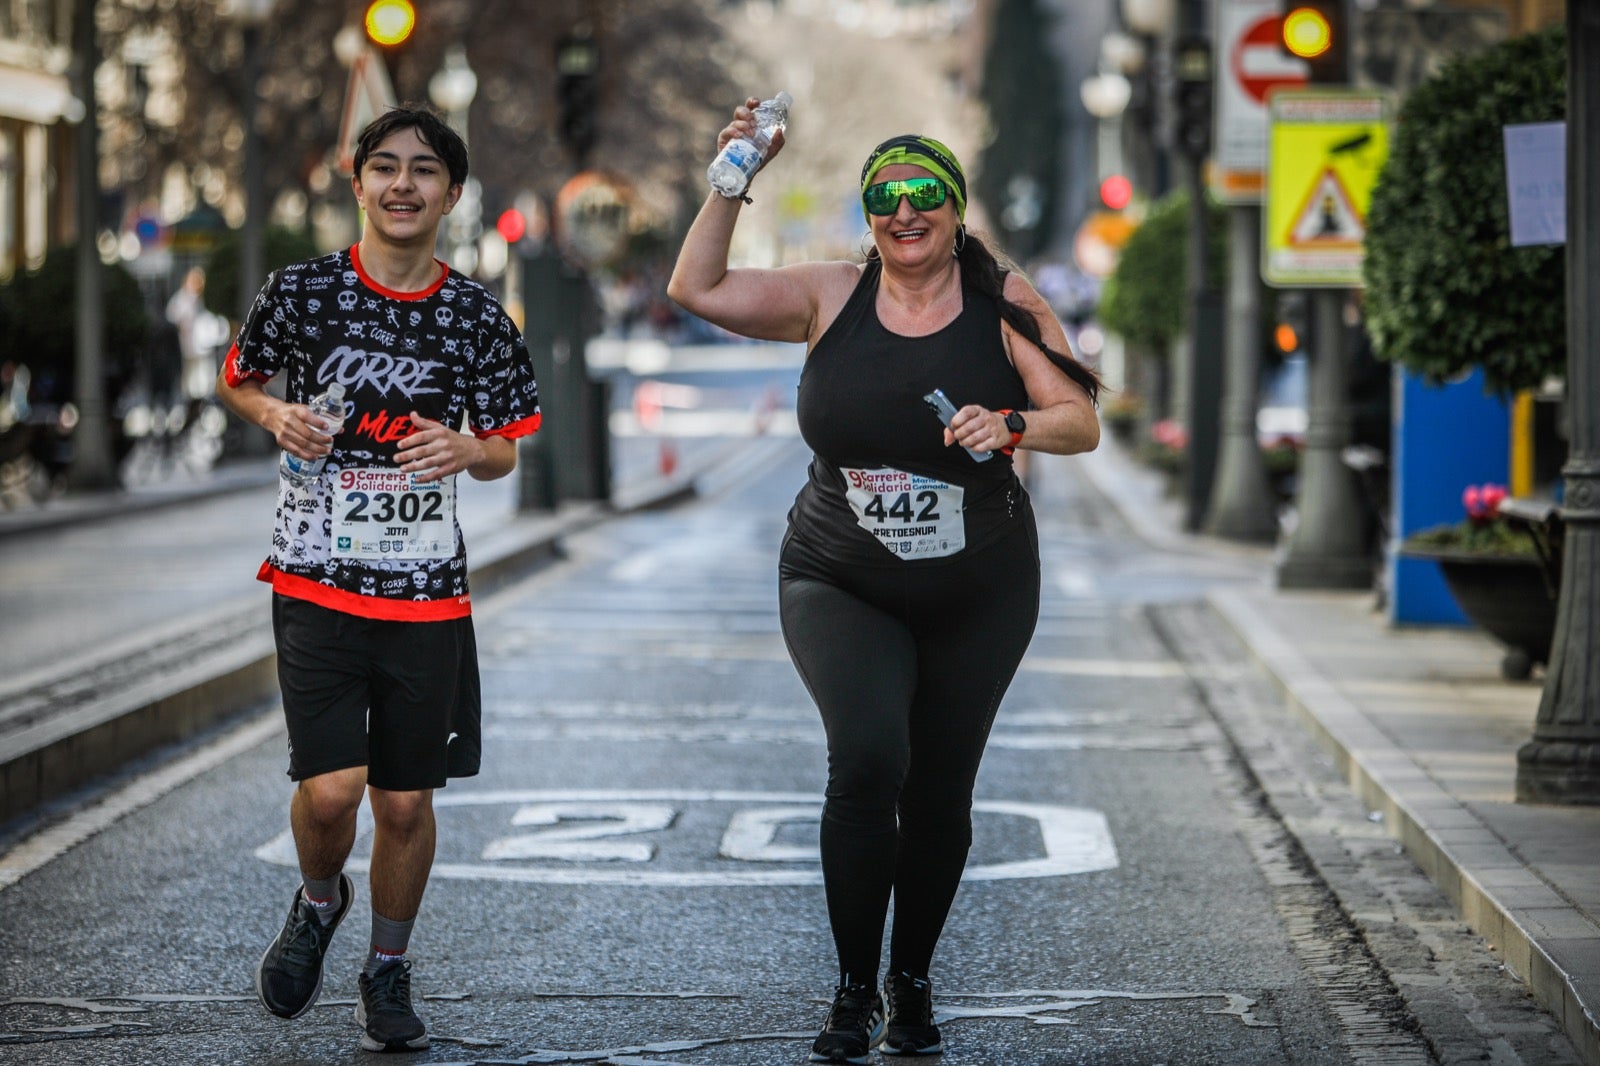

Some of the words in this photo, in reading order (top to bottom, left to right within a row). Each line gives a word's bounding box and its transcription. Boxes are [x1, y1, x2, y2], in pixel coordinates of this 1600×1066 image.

[305, 276, 335, 284] CORRE
[370, 327, 397, 347] CORRE
[317, 345, 447, 402] CORRE
[341, 471, 355, 490] 9
[357, 470, 407, 480] Carrera
[356, 480, 410, 491] Solidaria
[848, 470, 862, 488] 9
[860, 471, 907, 482] Carrera
[863, 481, 912, 493] Solidaria
[344, 491, 444, 523] 2302
[864, 490, 941, 524] 442
[384, 527, 409, 536] JOTA
[873, 525, 937, 538] #RETOESNUPI
[382, 578, 409, 589] CORRE
